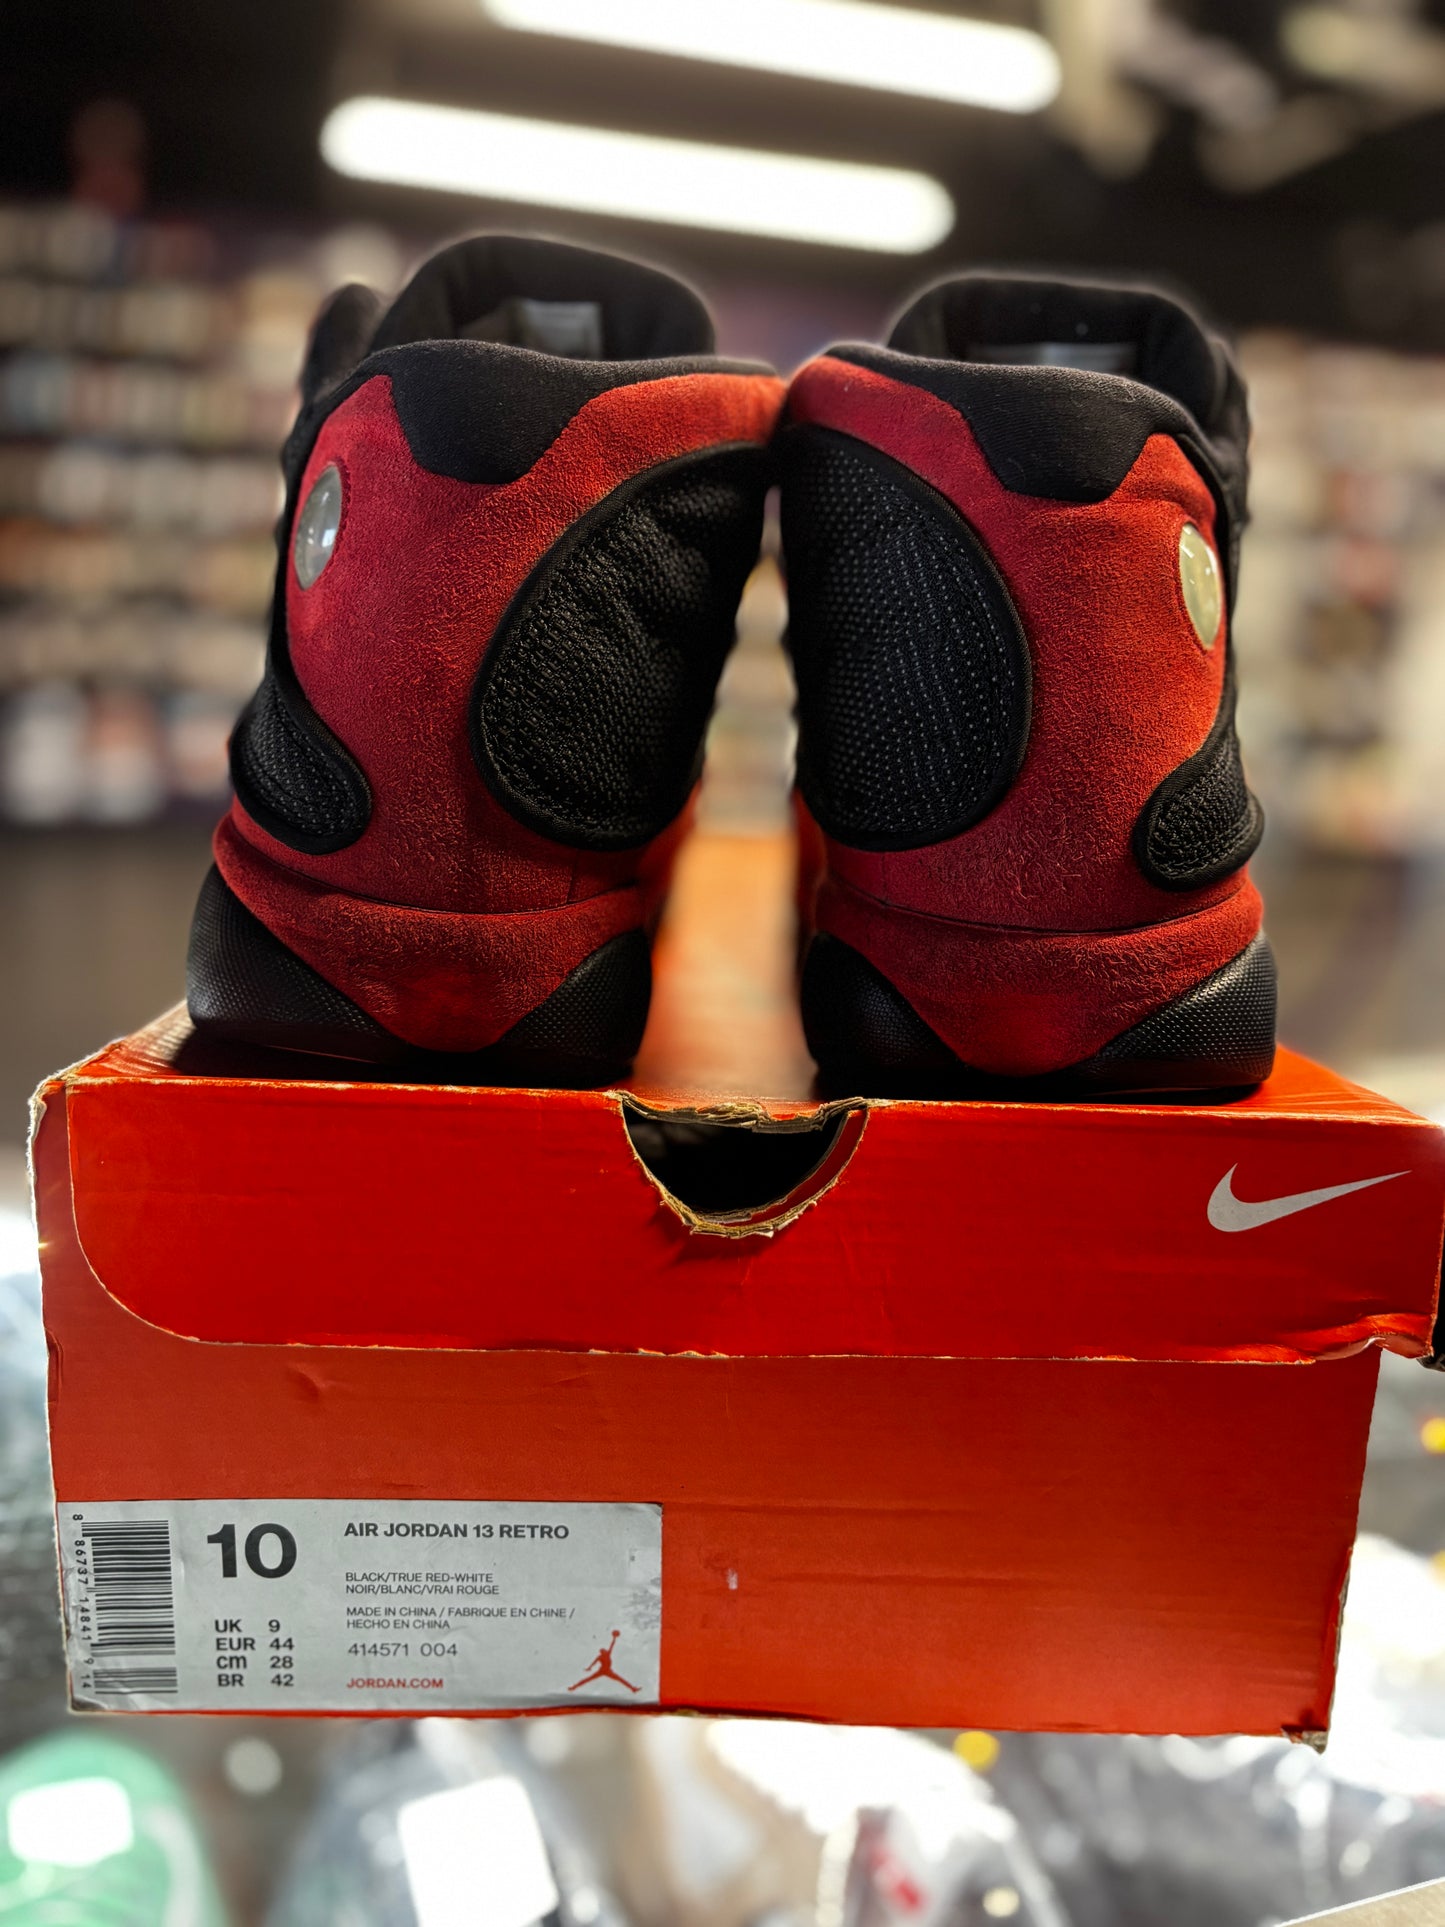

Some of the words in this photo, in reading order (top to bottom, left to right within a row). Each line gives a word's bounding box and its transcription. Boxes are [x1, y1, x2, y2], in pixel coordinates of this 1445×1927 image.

[72, 1513, 84, 1521] 8
[344, 1523, 379, 1537] AIR
[383, 1523, 468, 1538] JORDAN
[473, 1524, 494, 1538] 13
[499, 1525, 569, 1539] RETRO
[207, 1522, 297, 1579] 10
[74, 1540, 89, 1585] 86737
[345, 1572, 423, 1583] BLACK/TRUE
[425, 1573, 493, 1583] RED-WHITE
[346, 1584, 454, 1596] NOIR/BLANC/VRAI
[456, 1585, 500, 1595] ROUGE
[79, 1597, 92, 1641] 14841
[346, 1607, 381, 1617] MADE
[385, 1607, 396, 1617] IN
[399, 1607, 437, 1617] CHINA
[448, 1607, 507, 1618] FABRIQUE
[510, 1608, 527, 1618] EN
[529, 1608, 567, 1618] CHINE
[214, 1619, 242, 1633] UK
[268, 1619, 281, 1633] 9
[347, 1619, 390, 1629] HECHO
[393, 1619, 410, 1629] EN
[413, 1619, 450, 1629] CHINA
[216, 1637, 256, 1651] EUR
[269, 1637, 294, 1651] 44
[348, 1643, 409, 1656] 414571
[420, 1643, 458, 1657] 004
[83, 1657, 95, 1665] 9
[216, 1655, 247, 1669] cm
[270, 1656, 293, 1669] 28
[80, 1674, 92, 1689] 14
[217, 1674, 244, 1687] BR
[270, 1673, 294, 1687] 42
[346, 1678, 444, 1689] JORDAN.COM
